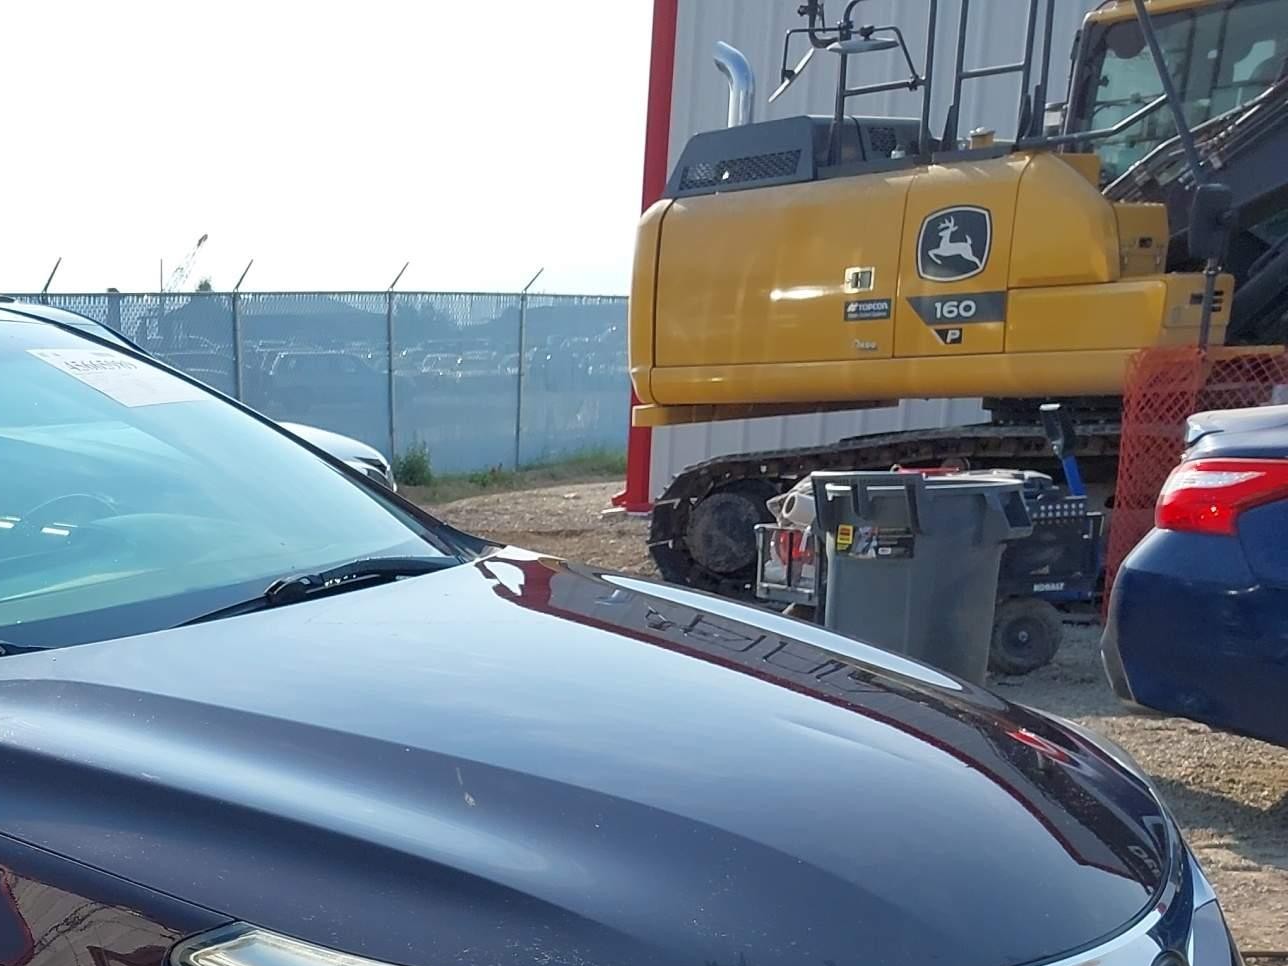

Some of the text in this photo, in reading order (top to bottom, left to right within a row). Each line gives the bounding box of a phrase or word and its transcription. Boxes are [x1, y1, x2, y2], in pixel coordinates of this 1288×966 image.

[858, 302, 888, 311] TOPCON
[934, 300, 976, 318] 160
[946, 329, 960, 343] P
